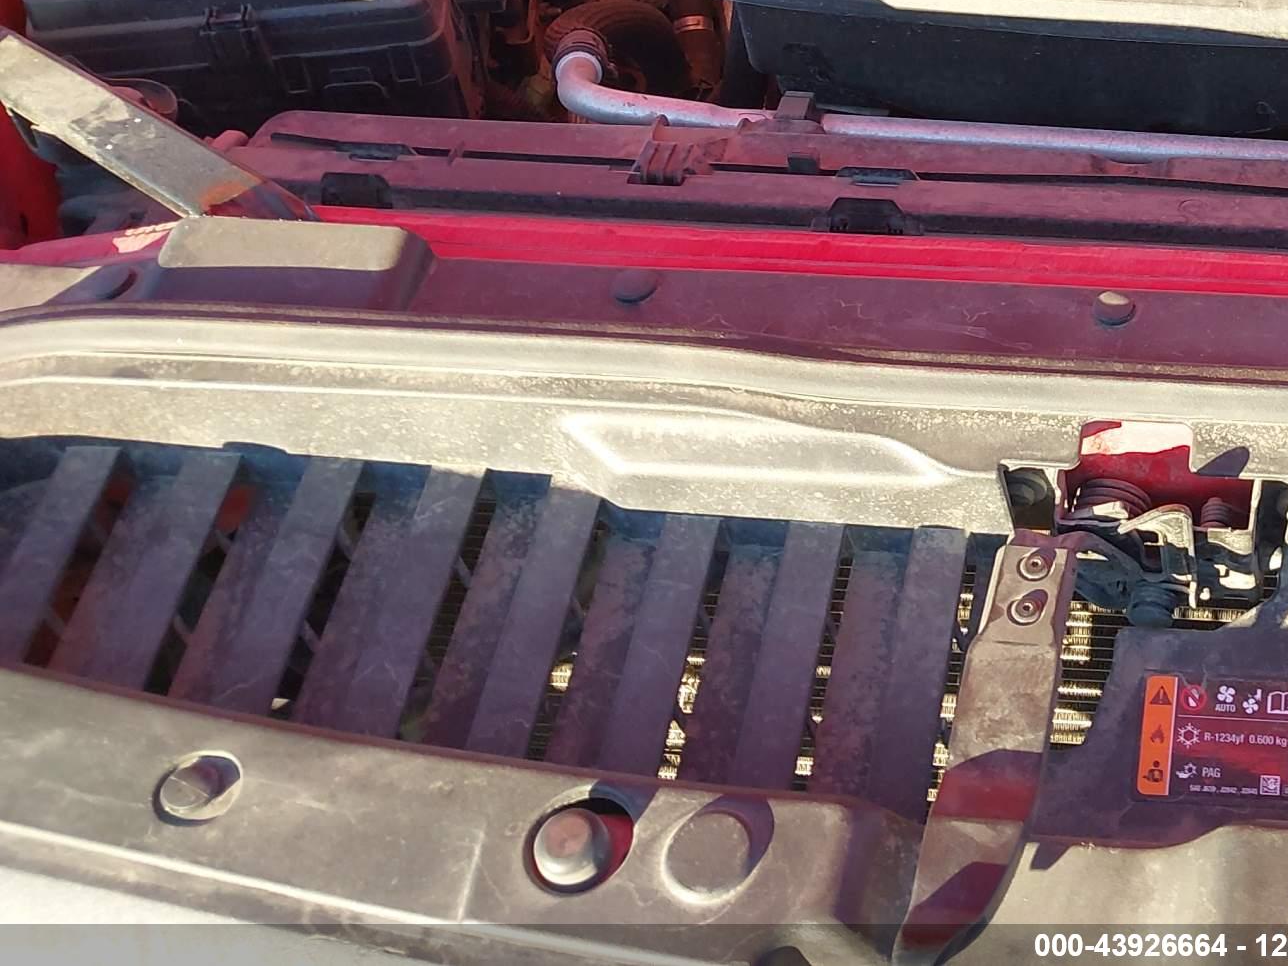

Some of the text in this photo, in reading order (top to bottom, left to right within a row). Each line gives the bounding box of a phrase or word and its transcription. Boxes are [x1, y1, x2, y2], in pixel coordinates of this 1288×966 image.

[1215, 704, 1236, 713] AUTO
[1203, 732, 1287, 748] R-1234yf 0.600 kg
[1202, 767, 1221, 778] PAG
